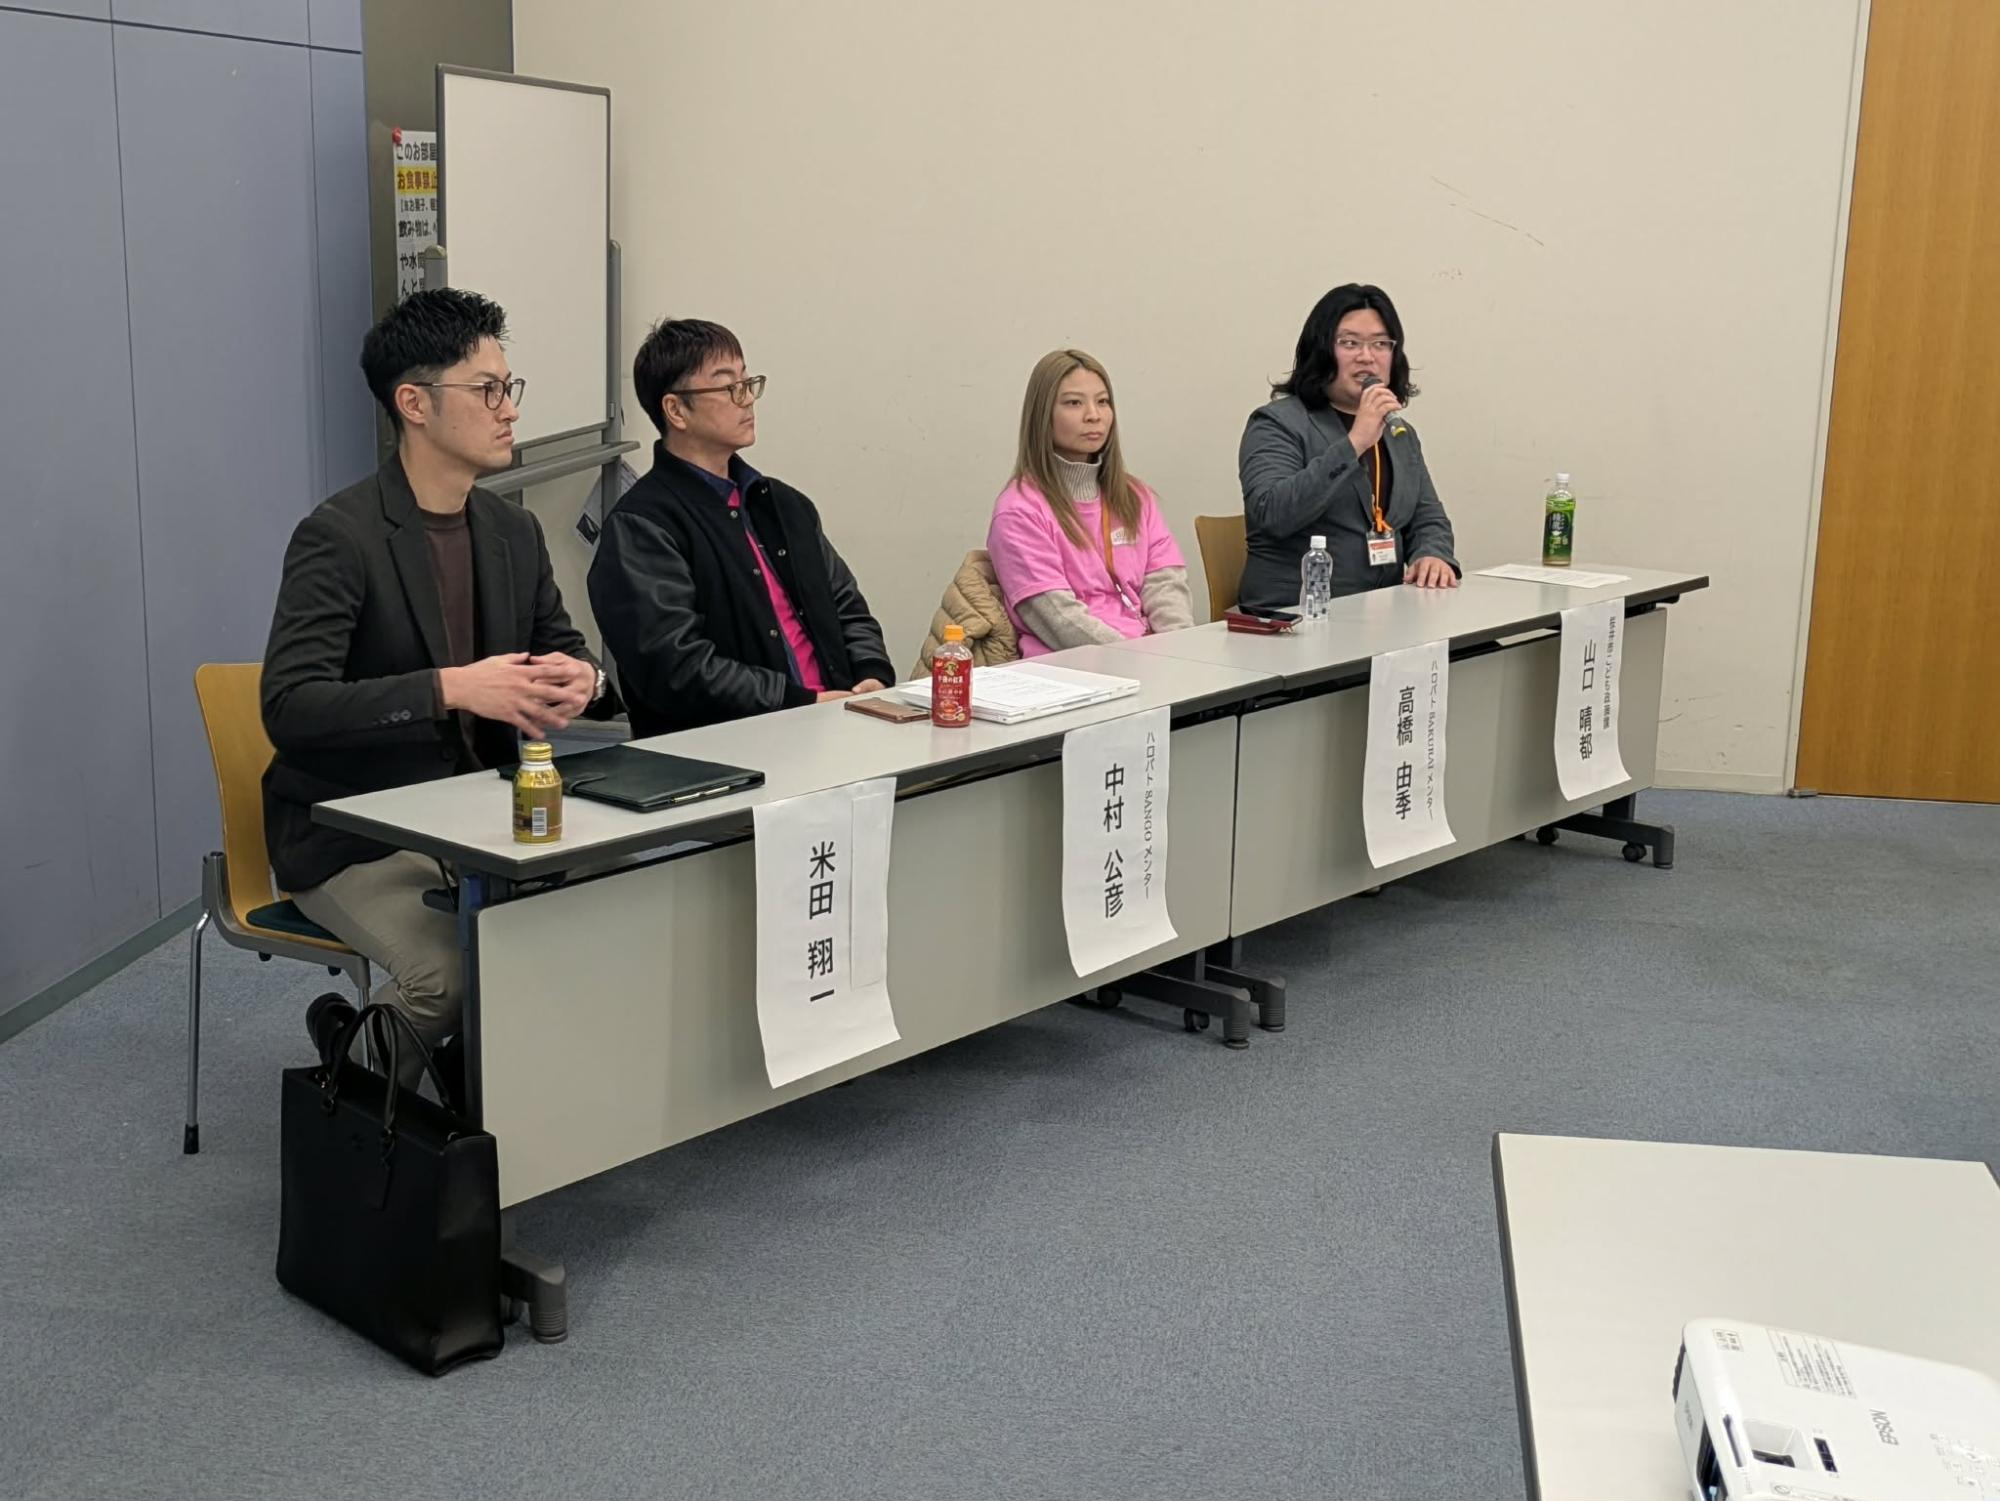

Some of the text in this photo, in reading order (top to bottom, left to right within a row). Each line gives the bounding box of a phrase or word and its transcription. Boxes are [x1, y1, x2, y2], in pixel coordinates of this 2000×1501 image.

[1395, 685, 1415, 820] 高橋 由季
[1579, 638, 1596, 761] 山口 晴都
[1103, 763, 1125, 919] 中村 公彦
[1143, 732, 1155, 899] ハロバト SANGO メンター
[807, 841, 836, 1002] 米田 翔一
[1869, 1408, 1899, 1446] EPSON
